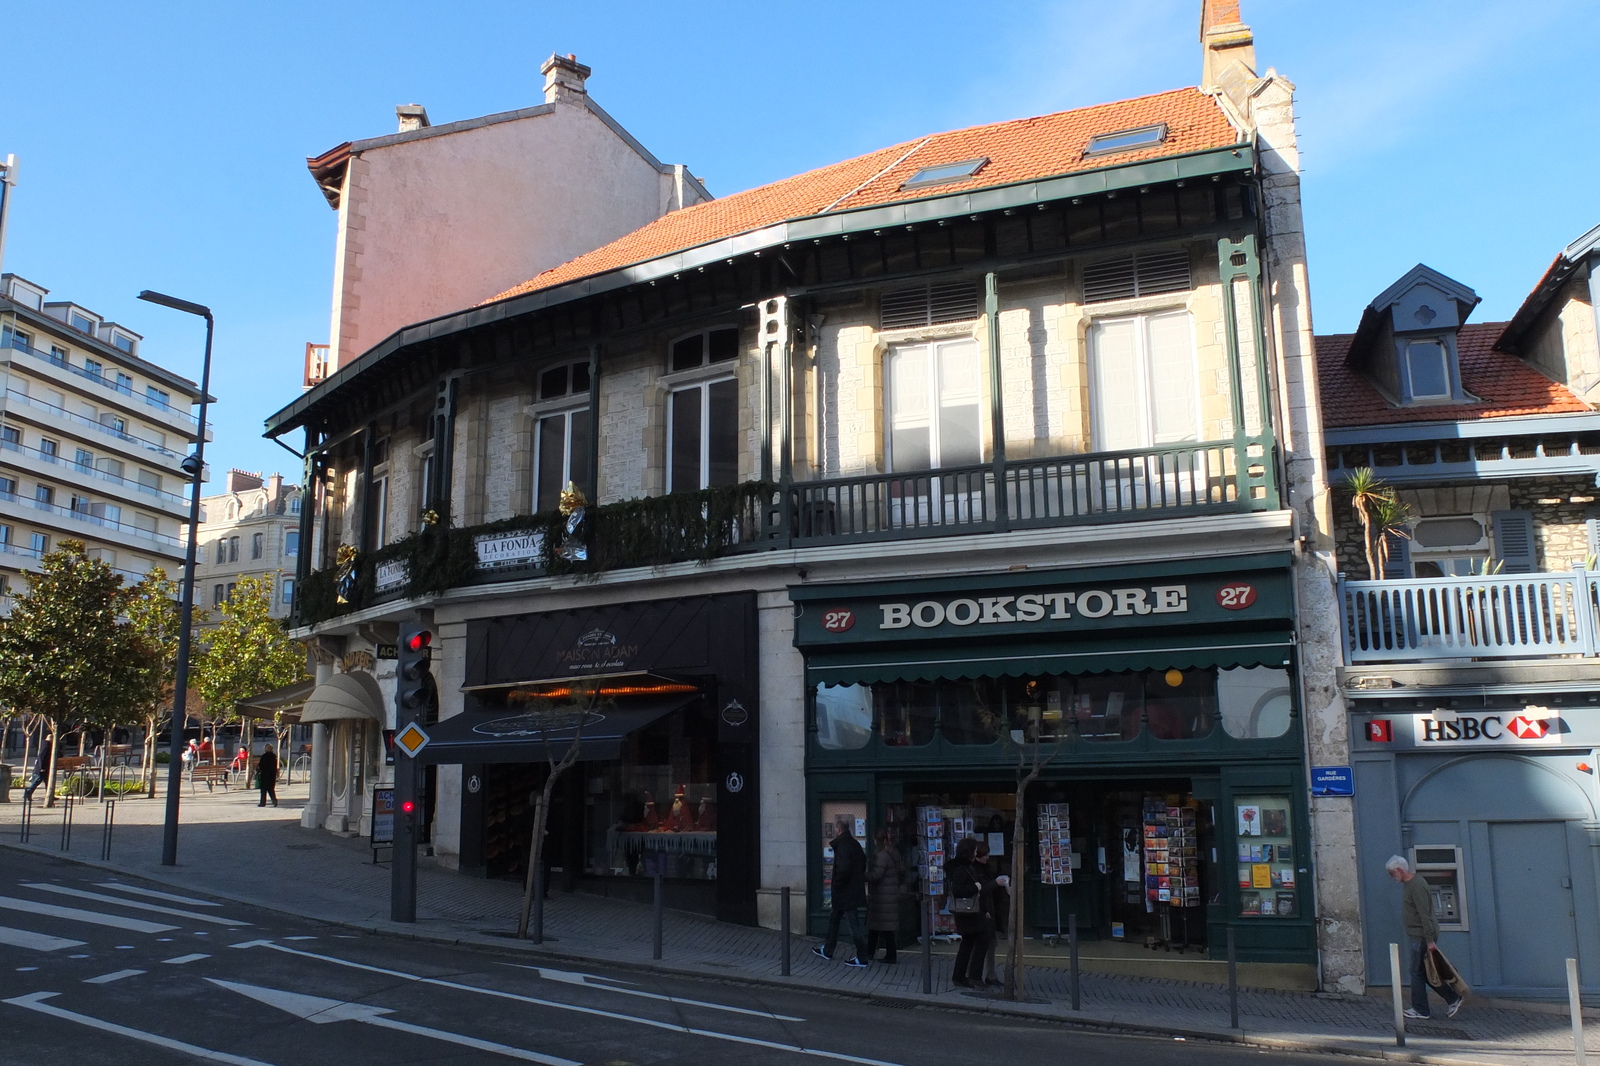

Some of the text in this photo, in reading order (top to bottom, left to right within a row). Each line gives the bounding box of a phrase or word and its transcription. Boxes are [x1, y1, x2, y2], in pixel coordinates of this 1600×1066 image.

[484, 537, 536, 554] LA FONDA
[388, 563, 403, 576] FOND
[1220, 587, 1251, 606] 27
[880, 585, 1188, 630] BOOKSTORE
[825, 611, 851, 629] 27
[379, 646, 398, 657] ACH
[556, 645, 638, 662] MAISON ADAM
[1421, 716, 1502, 742] HSBC
[378, 791, 394, 800] ACH
